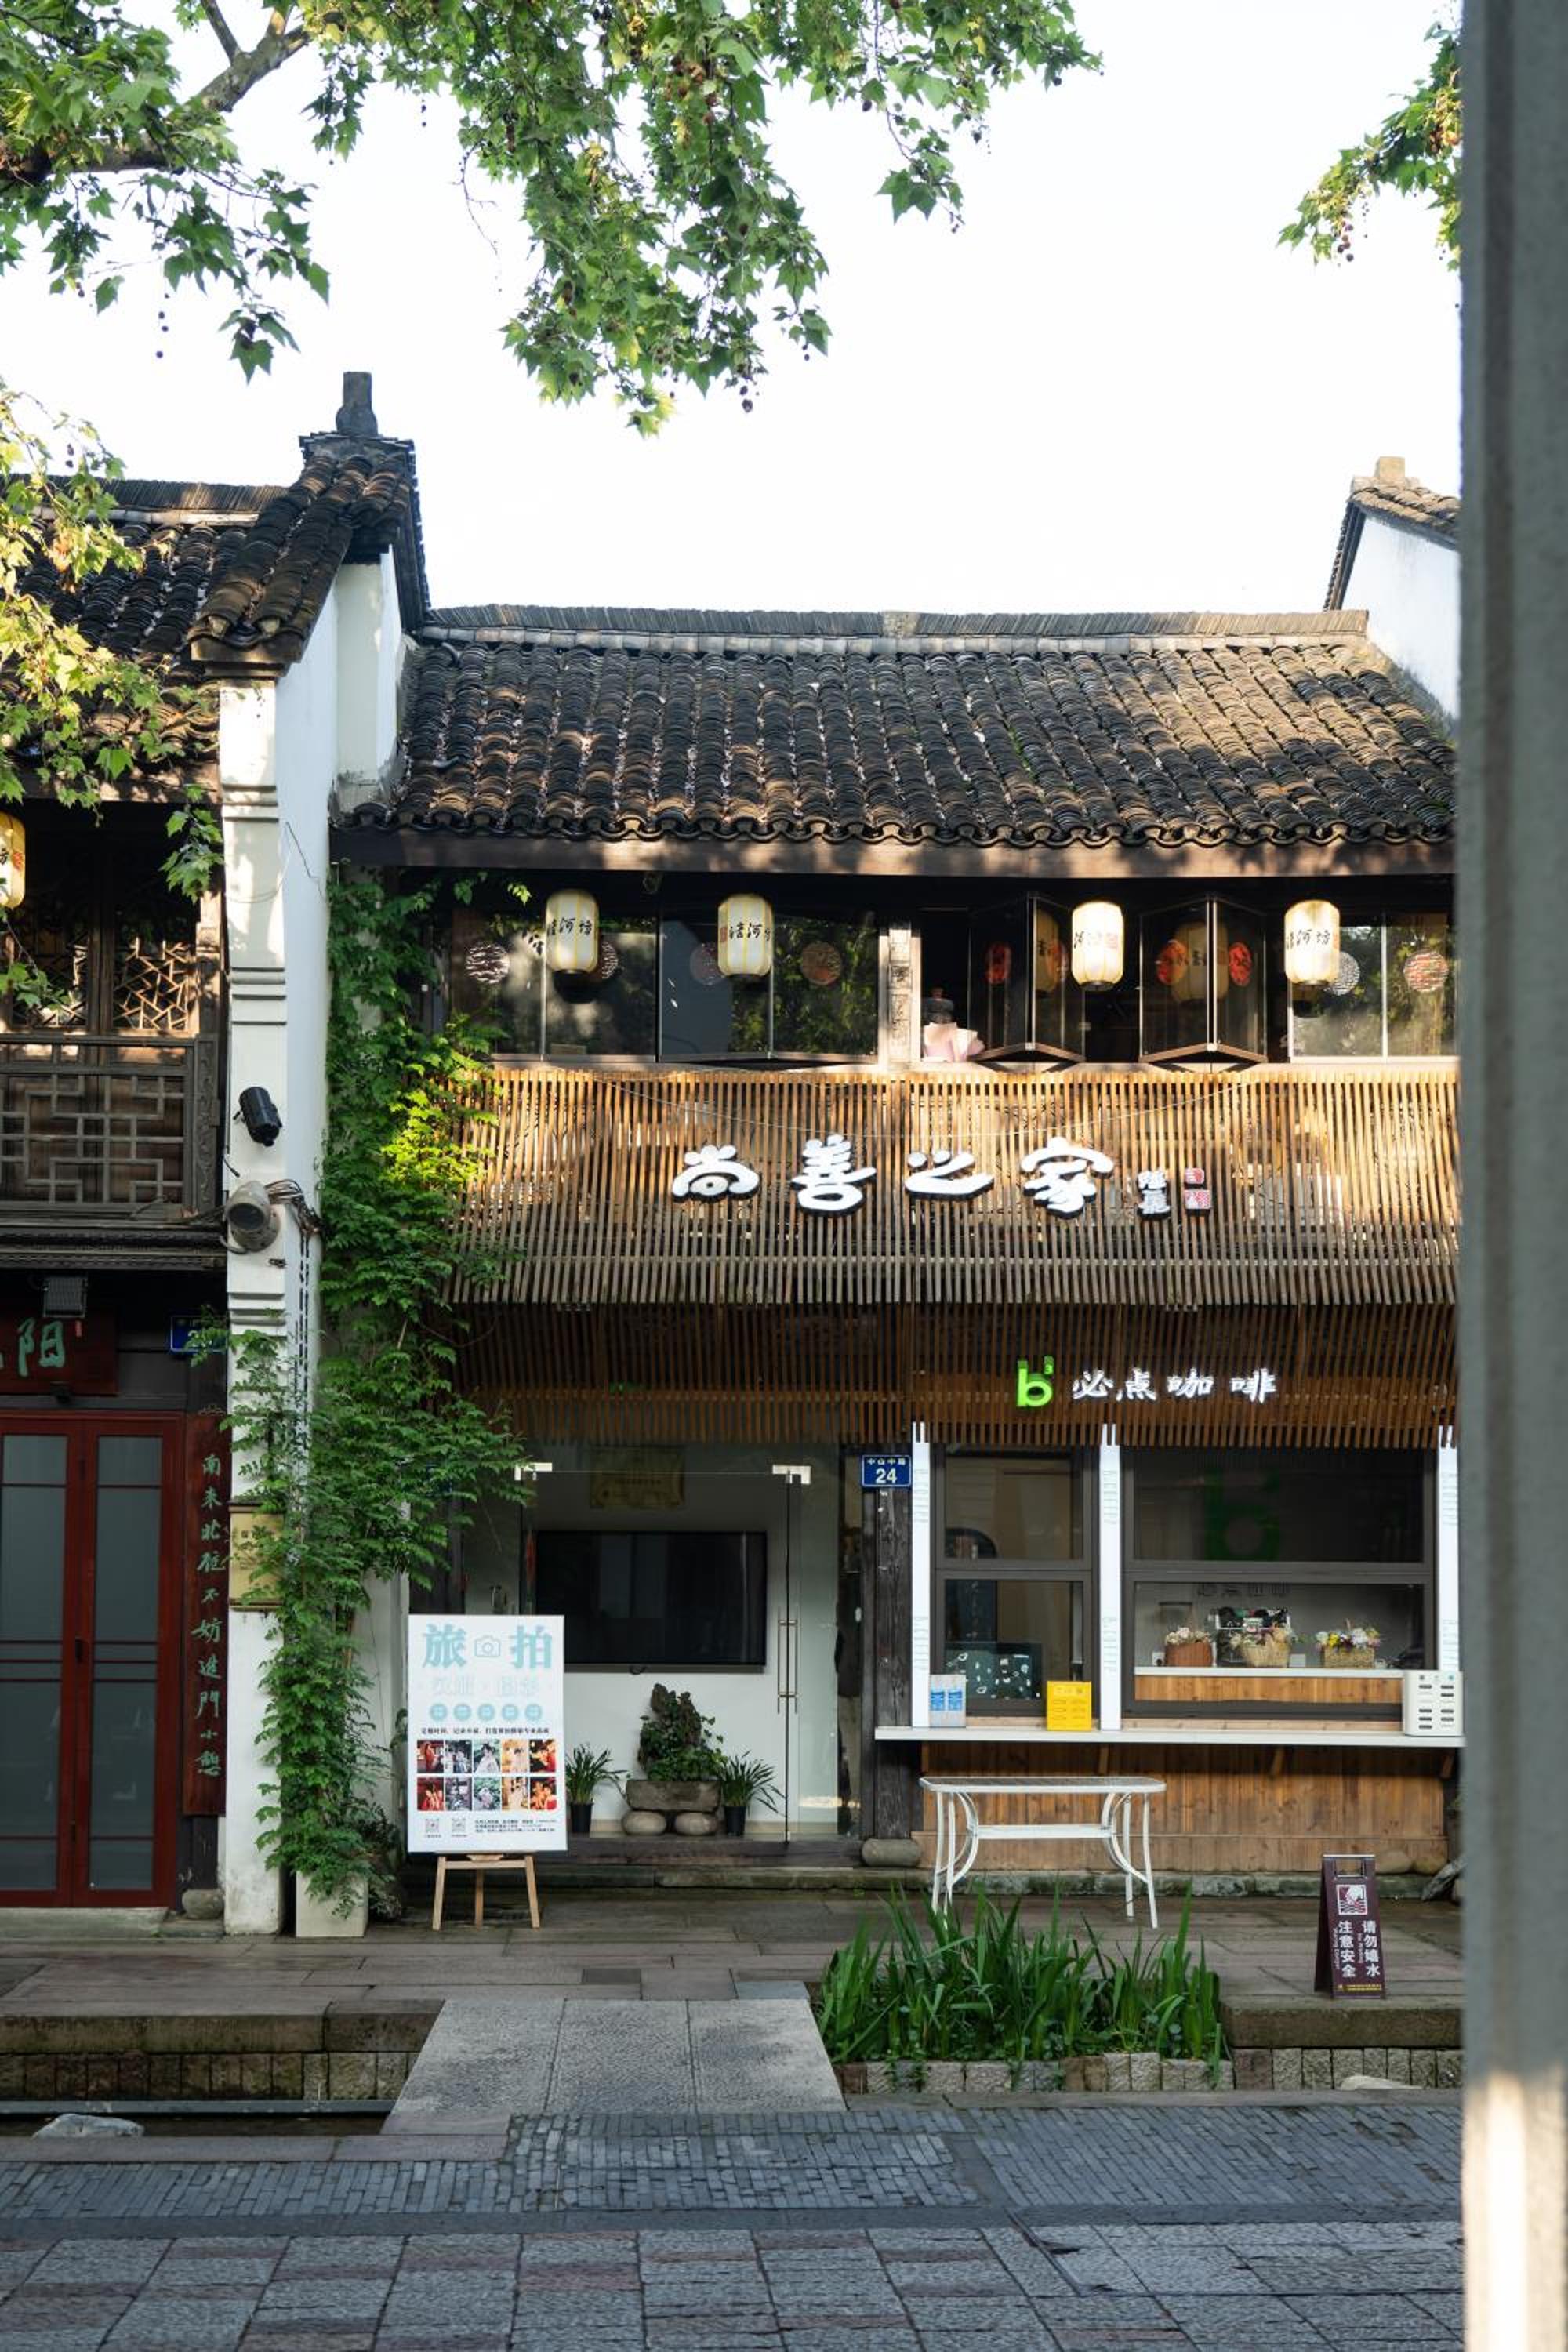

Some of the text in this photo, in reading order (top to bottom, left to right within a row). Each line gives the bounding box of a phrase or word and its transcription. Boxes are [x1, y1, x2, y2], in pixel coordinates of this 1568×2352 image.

[672, 1134, 1114, 1218] 尚善之家
[1072, 1368, 1276, 1403] 必点咖啡
[876, 1468, 897, 1483] 24
[1338, 1921, 1356, 1977] 注意安全
